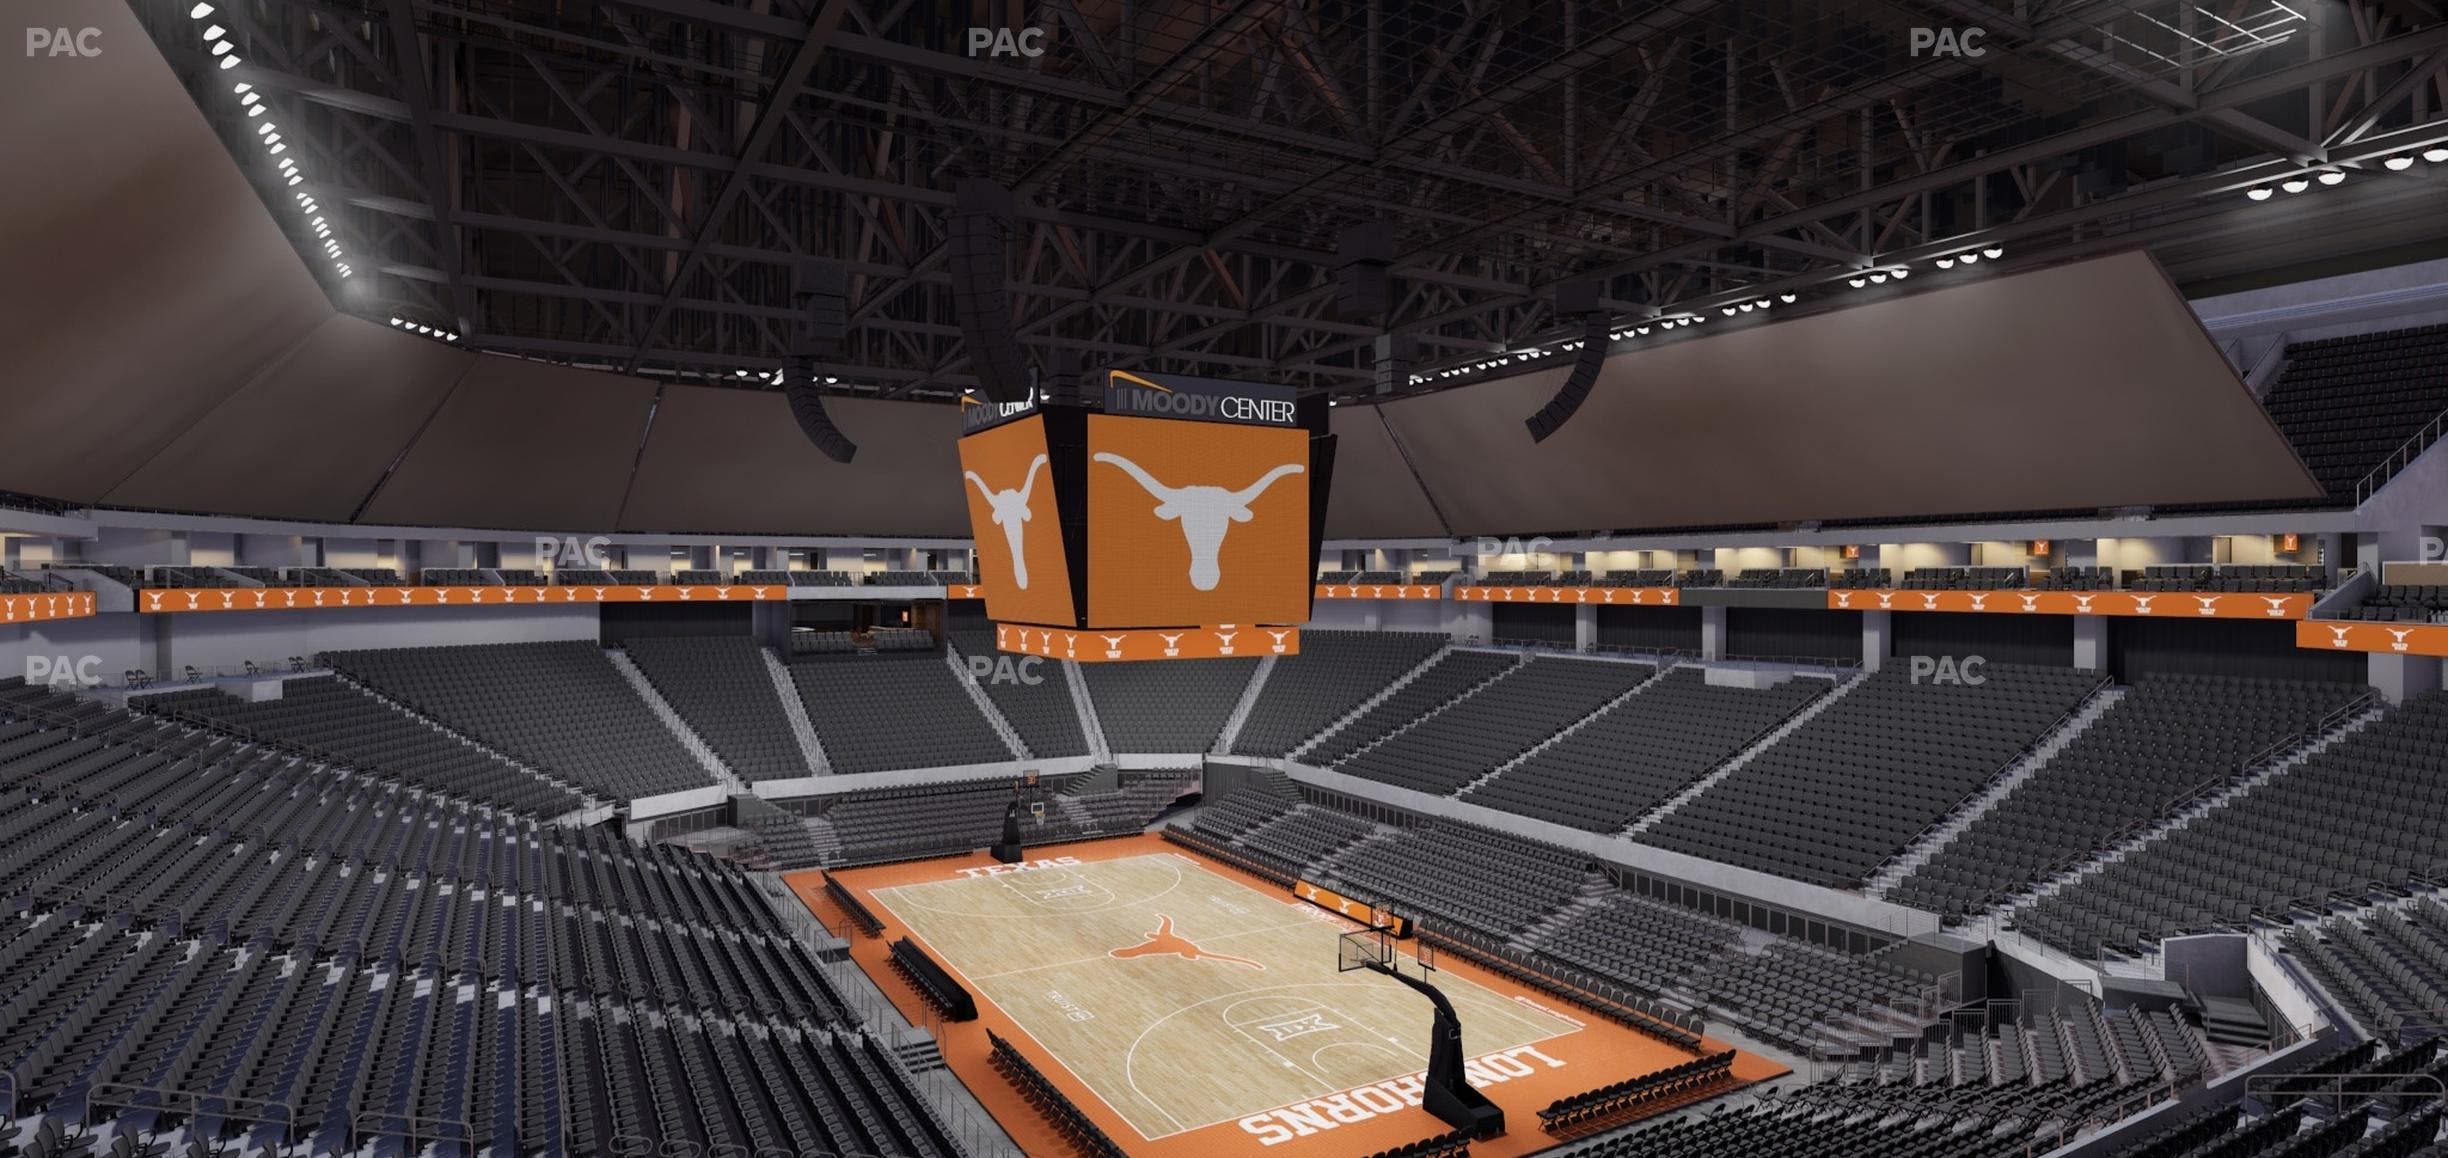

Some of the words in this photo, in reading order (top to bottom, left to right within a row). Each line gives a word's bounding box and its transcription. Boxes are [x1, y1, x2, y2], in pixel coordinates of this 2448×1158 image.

[1132, 388, 1221, 417] MOODY
[1220, 396, 1296, 423] CENTER
[955, 856, 1082, 878] TEXAS
[1238, 1045, 1567, 1146] LONHORNS
